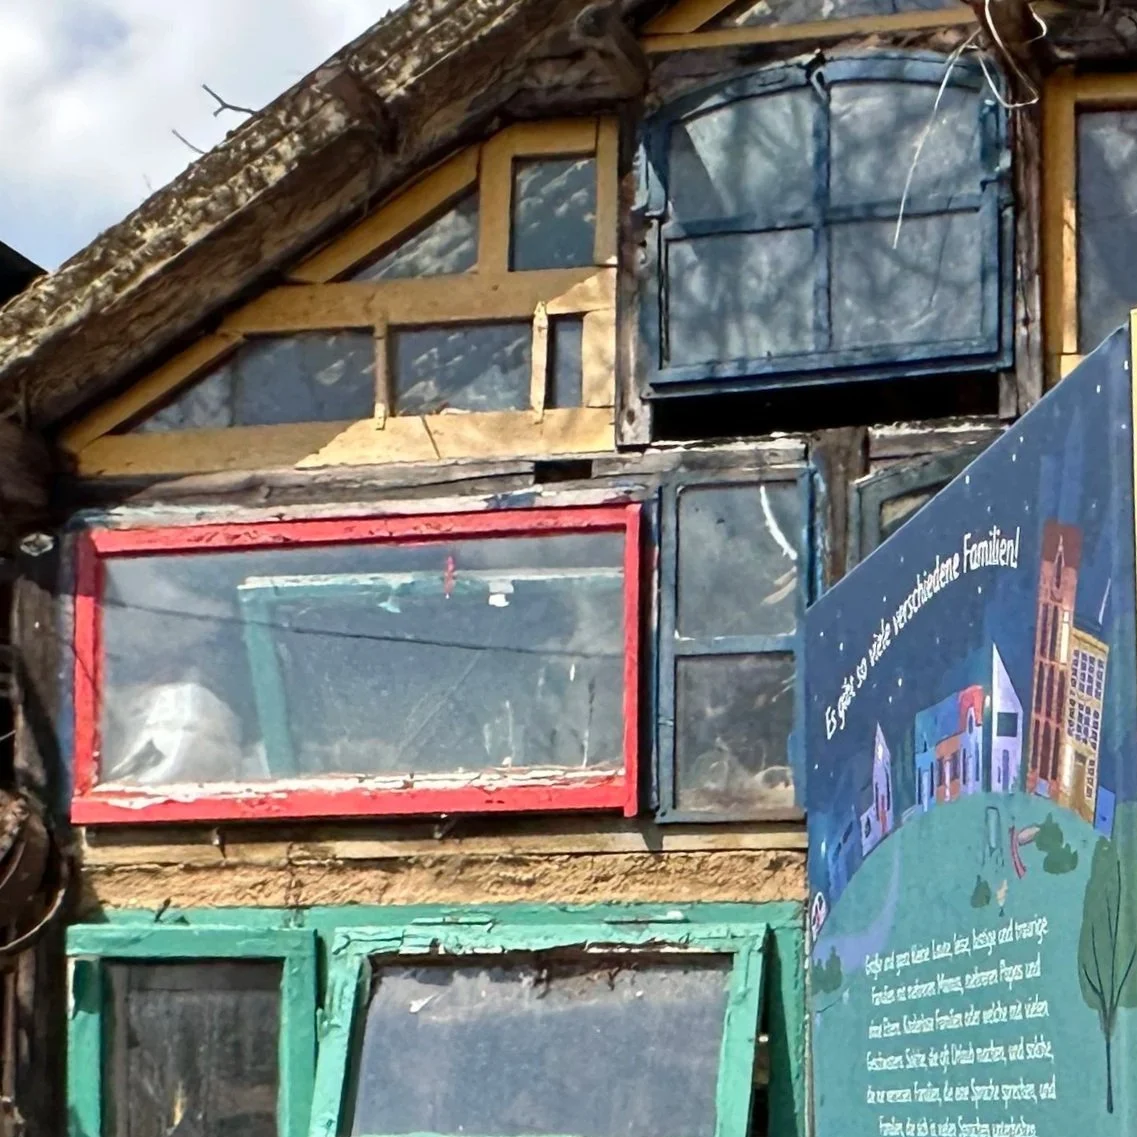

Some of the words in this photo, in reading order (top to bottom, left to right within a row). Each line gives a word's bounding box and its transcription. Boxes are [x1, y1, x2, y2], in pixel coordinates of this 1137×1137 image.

[825, 705, 838, 740] Es
[857, 657, 868, 689] so
[869, 618, 891, 667] viele
[892, 552, 960, 636] verschiedene
[963, 525, 1020, 574] Familien!
[1024, 952, 1041, 979] und
[1039, 1073, 1057, 1100] und
